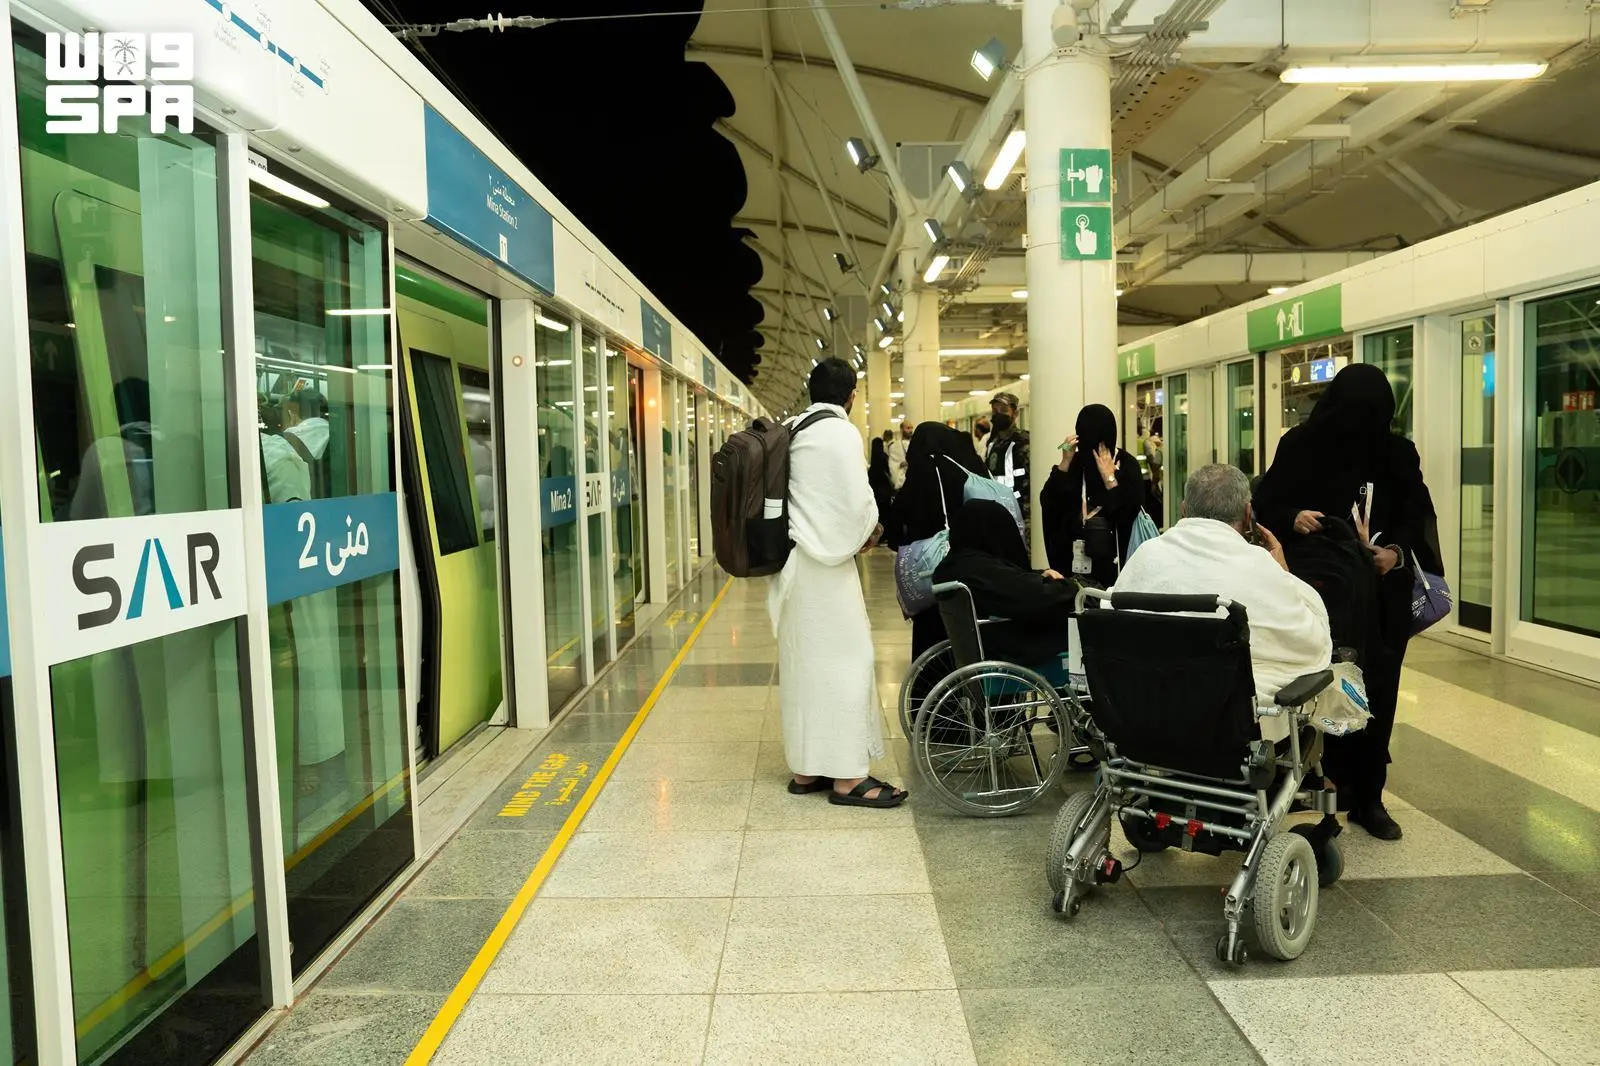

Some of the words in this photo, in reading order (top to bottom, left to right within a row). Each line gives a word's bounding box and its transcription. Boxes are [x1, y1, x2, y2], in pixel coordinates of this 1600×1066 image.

[486, 193, 499, 215] Mina
[499, 203, 515, 227] Station
[550, 490, 566, 512] Mina
[566, 487, 572, 508] 2
[586, 480, 602, 508] SAR
[297, 511, 318, 569] 2
[325, 514, 369, 576] منى
[72, 531, 223, 631] SAR
[496, 791, 541, 817] MIND
[520, 771, 558, 789] THE
